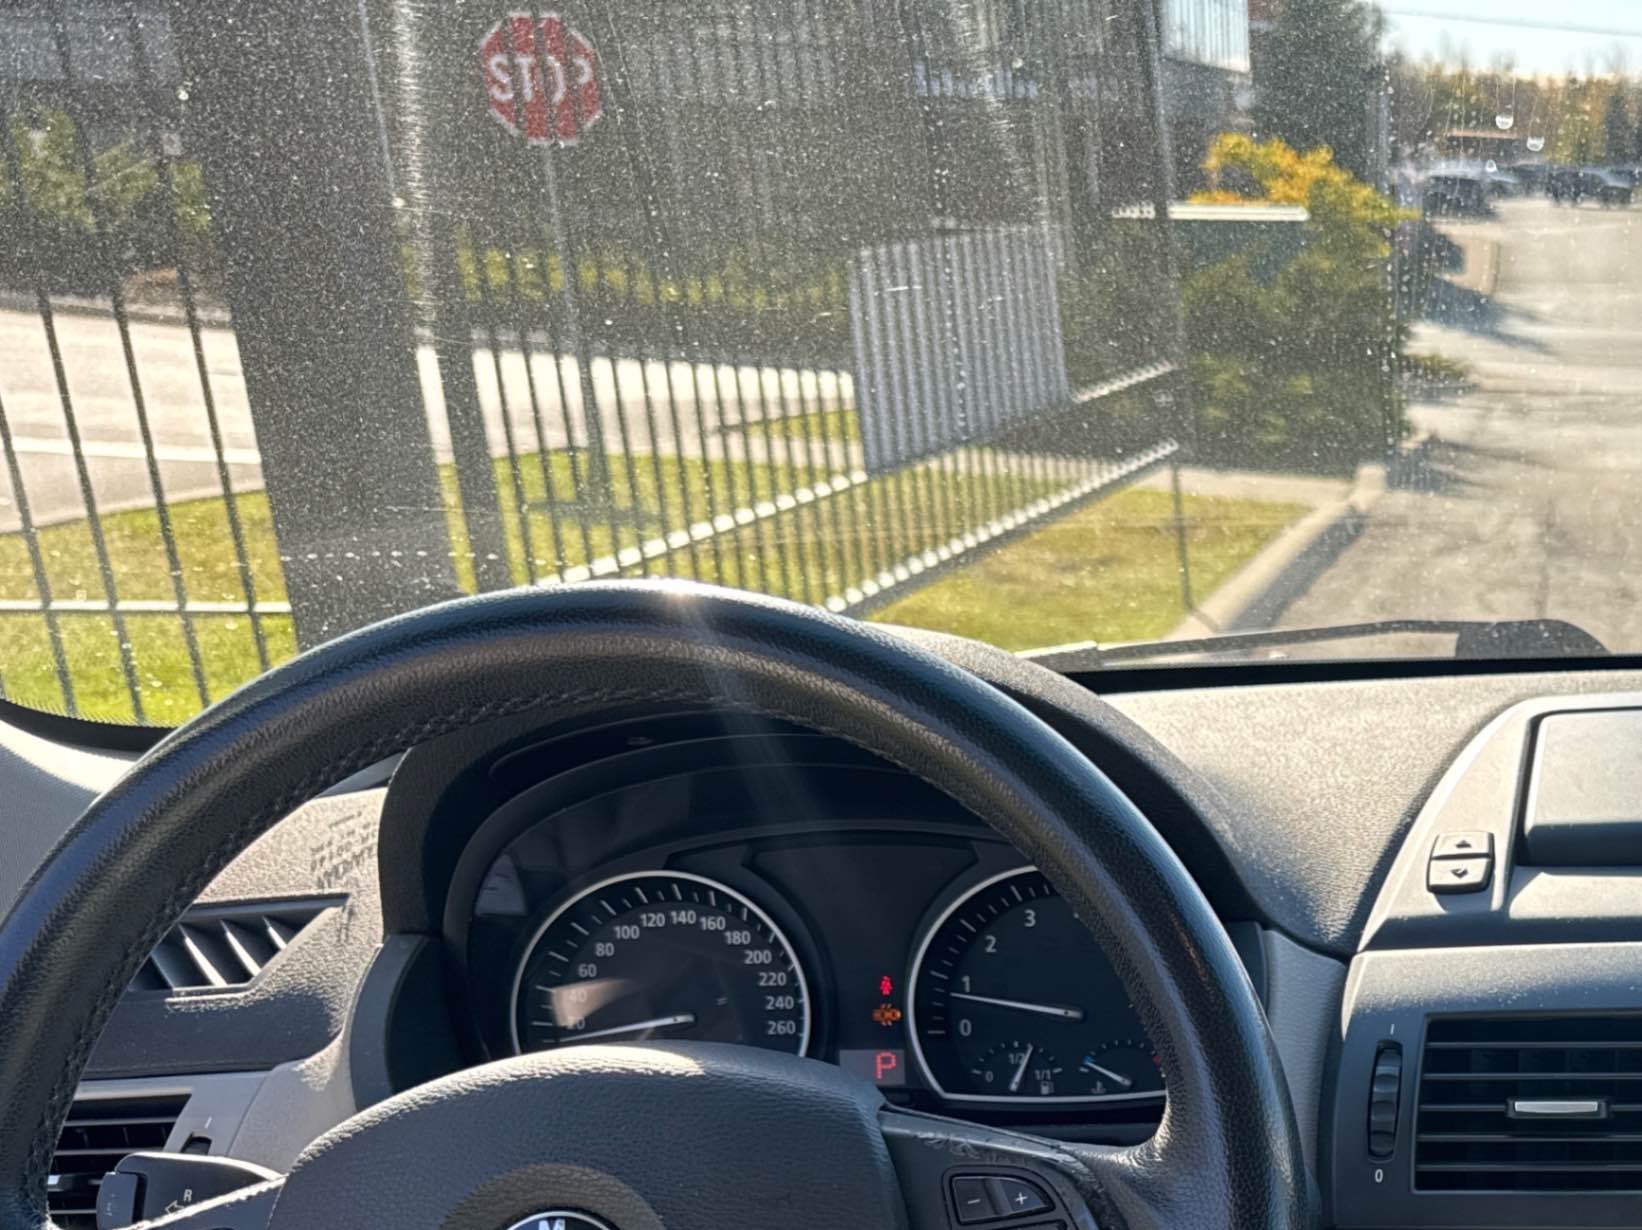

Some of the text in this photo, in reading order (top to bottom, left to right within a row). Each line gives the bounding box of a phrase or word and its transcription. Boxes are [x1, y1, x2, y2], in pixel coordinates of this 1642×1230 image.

[640, 913, 666, 928] 120
[670, 910, 697, 925] 140
[700, 916, 726, 931] 160
[1024, 909, 1037, 928] 3
[613, 925, 640, 939] 100
[724, 930, 751, 945] 180
[595, 942, 615, 957] 80
[985, 935, 998, 953] 2
[744, 950, 772, 964] 200
[577, 963, 598, 978] 60
[758, 972, 787, 986] 220
[962, 975, 971, 992] 1
[765, 996, 795, 1010] 240
[767, 1020, 796, 1035] 260
[959, 1019, 972, 1037] 0
[875, 1051, 897, 1080] P
[1374, 1168, 1384, 1183] 0
